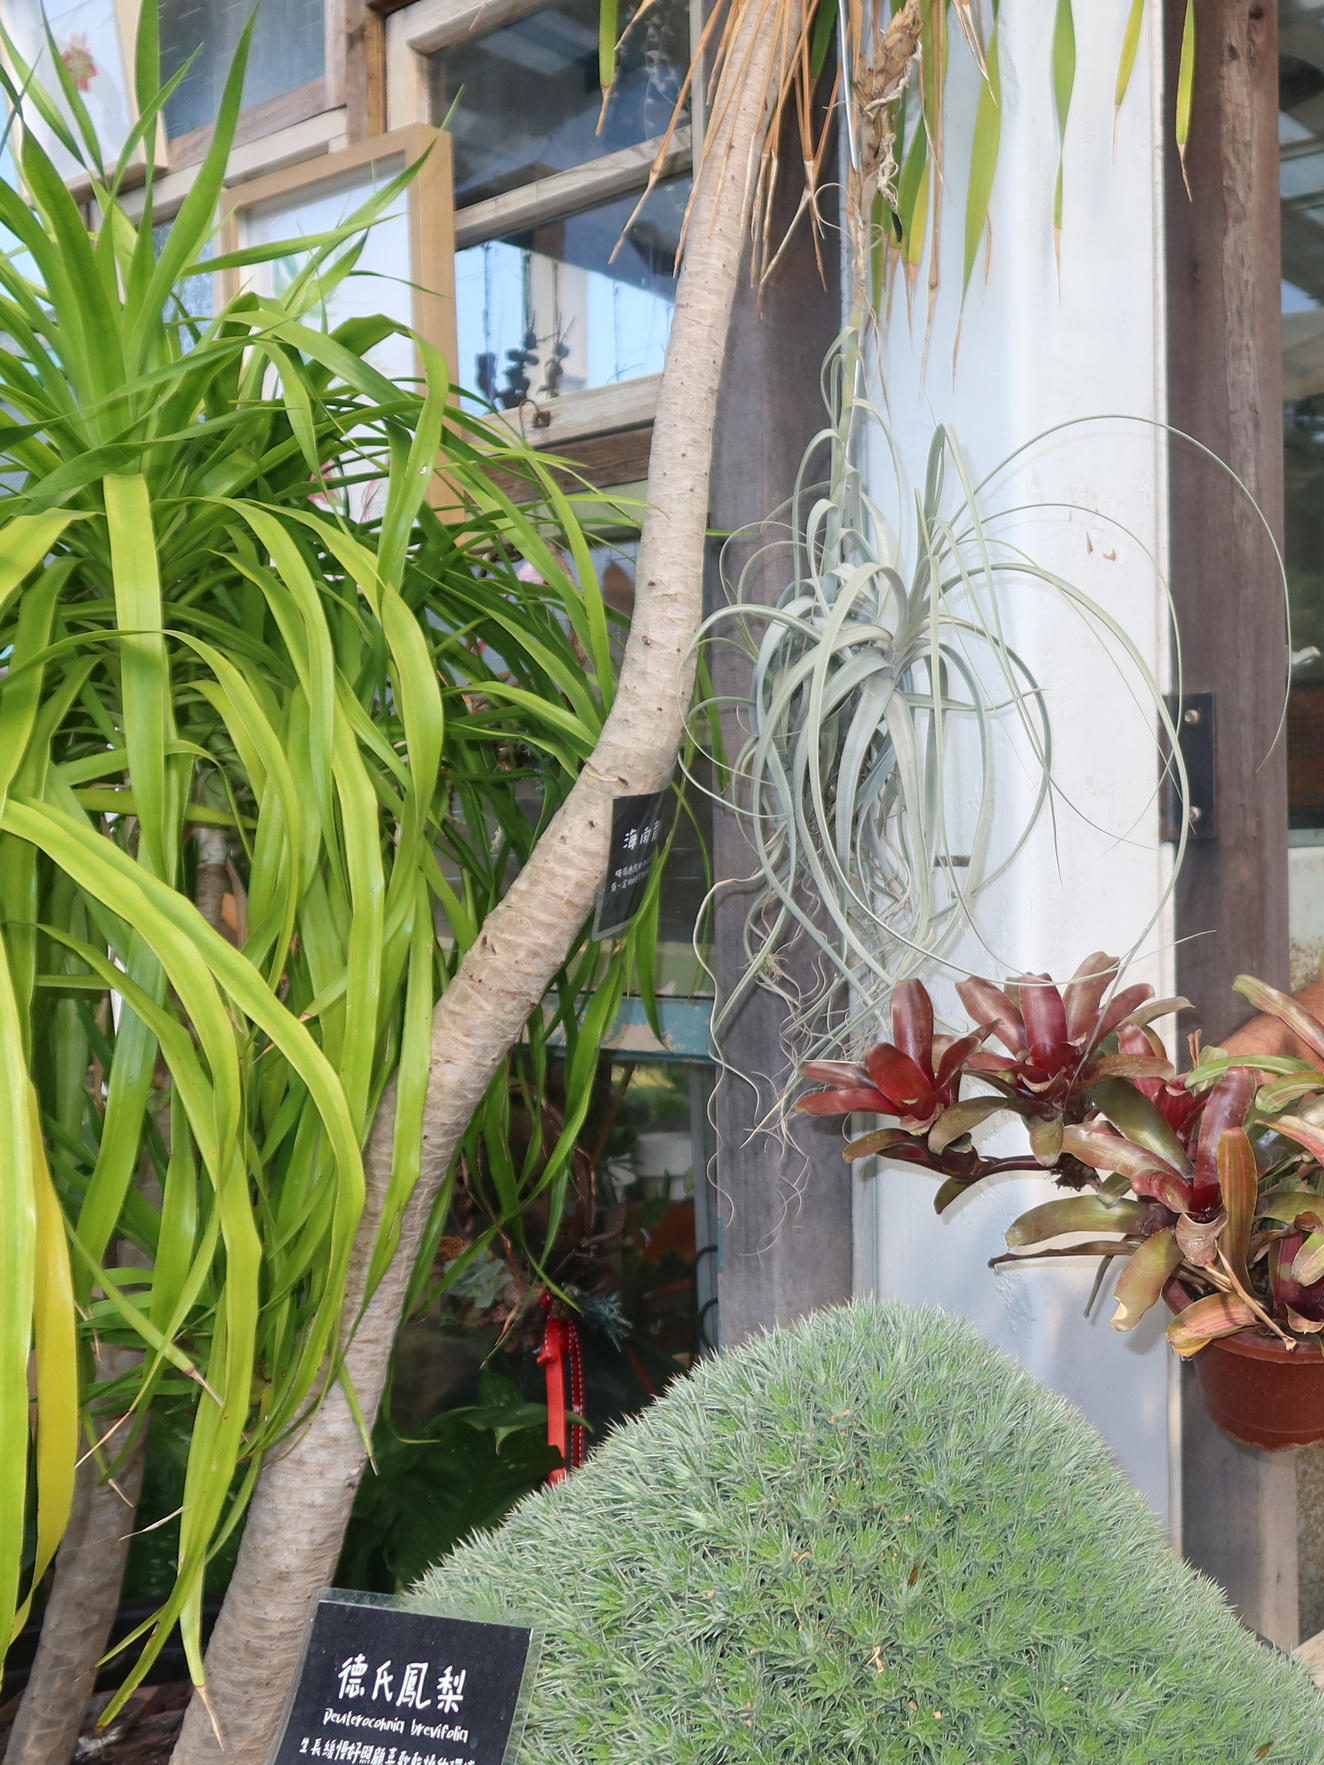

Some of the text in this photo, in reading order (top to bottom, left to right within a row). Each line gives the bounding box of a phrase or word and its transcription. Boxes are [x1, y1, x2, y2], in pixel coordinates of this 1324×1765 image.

[338, 1653, 466, 1713] 德氏鳳梨
[323, 1707, 469, 1743] Deuterocohnia brevifolia
[299, 1736, 476, 1765] 生長緩慢好照顧喜歡乾燥的
